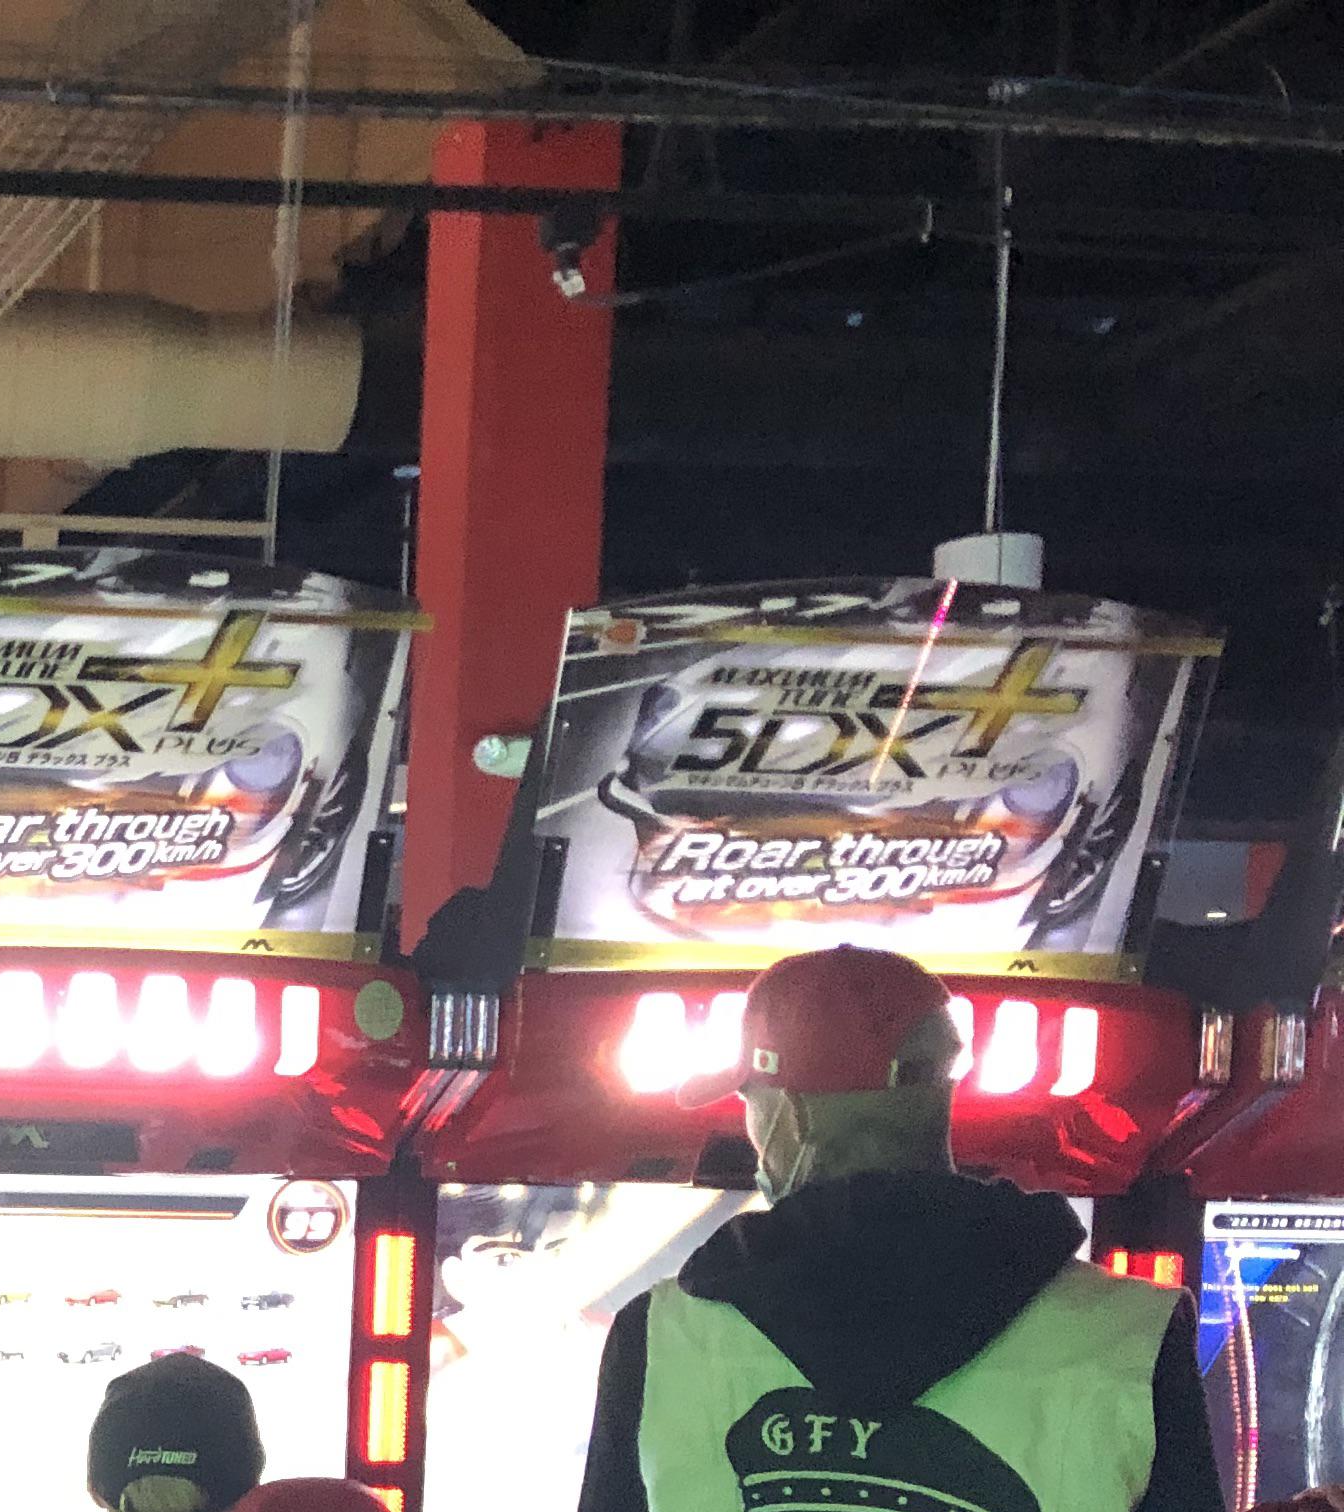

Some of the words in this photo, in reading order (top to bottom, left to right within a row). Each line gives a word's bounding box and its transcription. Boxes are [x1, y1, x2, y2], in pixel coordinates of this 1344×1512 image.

[53, 805, 231, 846] through
[659, 830, 823, 872] Roar
[827, 830, 1005, 869] through
[736, 874, 828, 900] over
[762, 1413, 883, 1460] GFY
